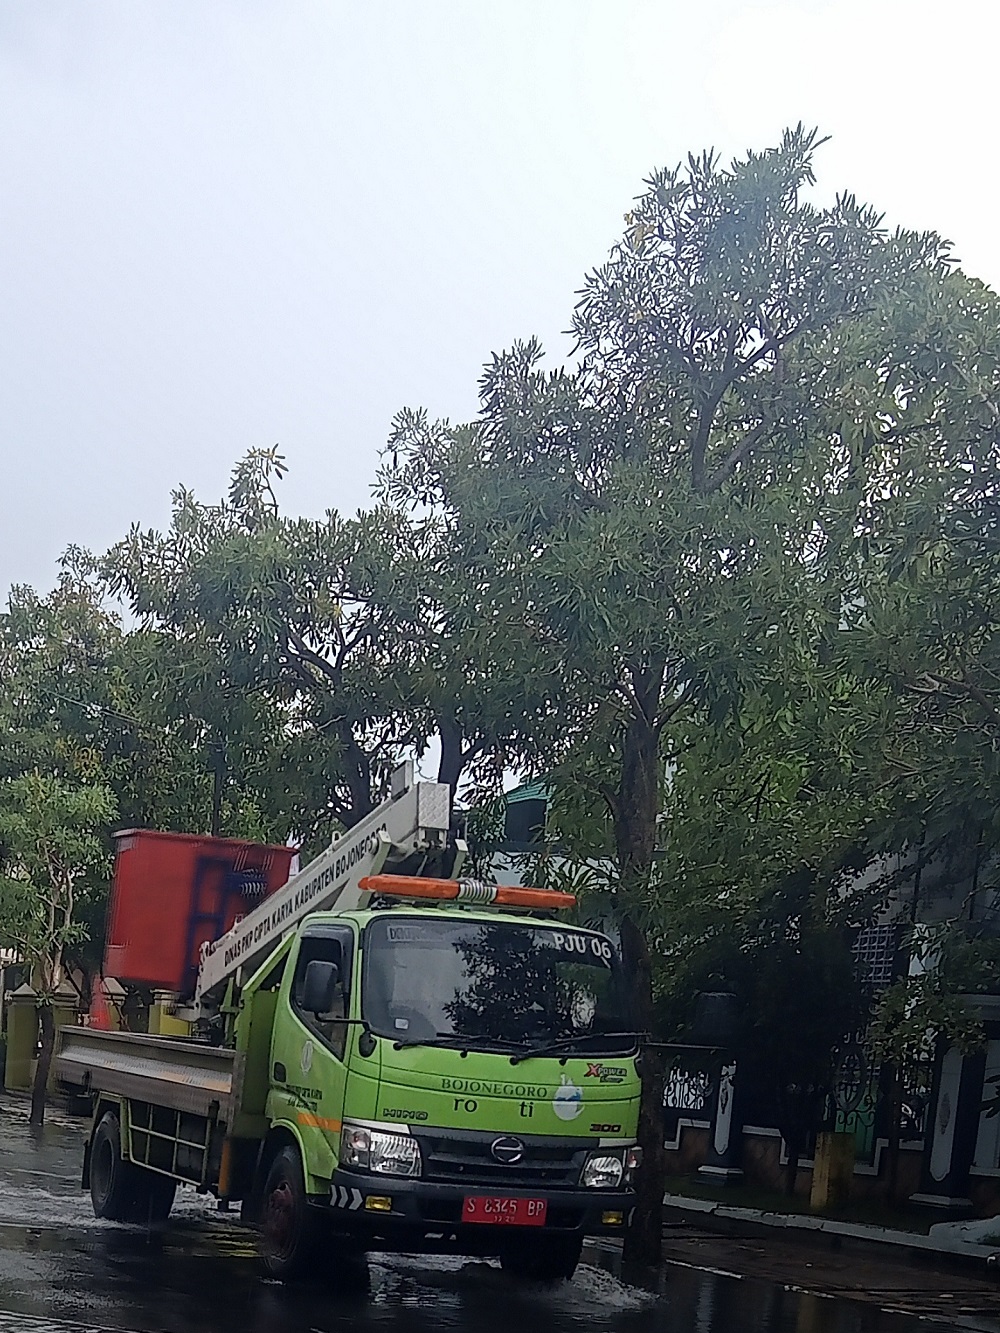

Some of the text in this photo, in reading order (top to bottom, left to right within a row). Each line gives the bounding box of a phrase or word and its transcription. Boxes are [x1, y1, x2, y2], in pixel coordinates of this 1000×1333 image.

[224, 939, 241, 967] DINAS
[241, 930, 253, 953] PKP
[253, 916, 270, 943] CIPTA
[271, 898, 293, 929] KARYA
[294, 862, 335, 911] KABUPATEN
[552, 932, 612, 959] PJU 06
[441, 1078, 548, 1098] BOJONEGORO
[382, 1107, 429, 1121] HINO
[453, 1097, 534, 1118] ro ti
[590, 1123, 622, 1133] 300
[467, 1197, 476, 1213] S
[527, 1200, 544, 1216] BP
